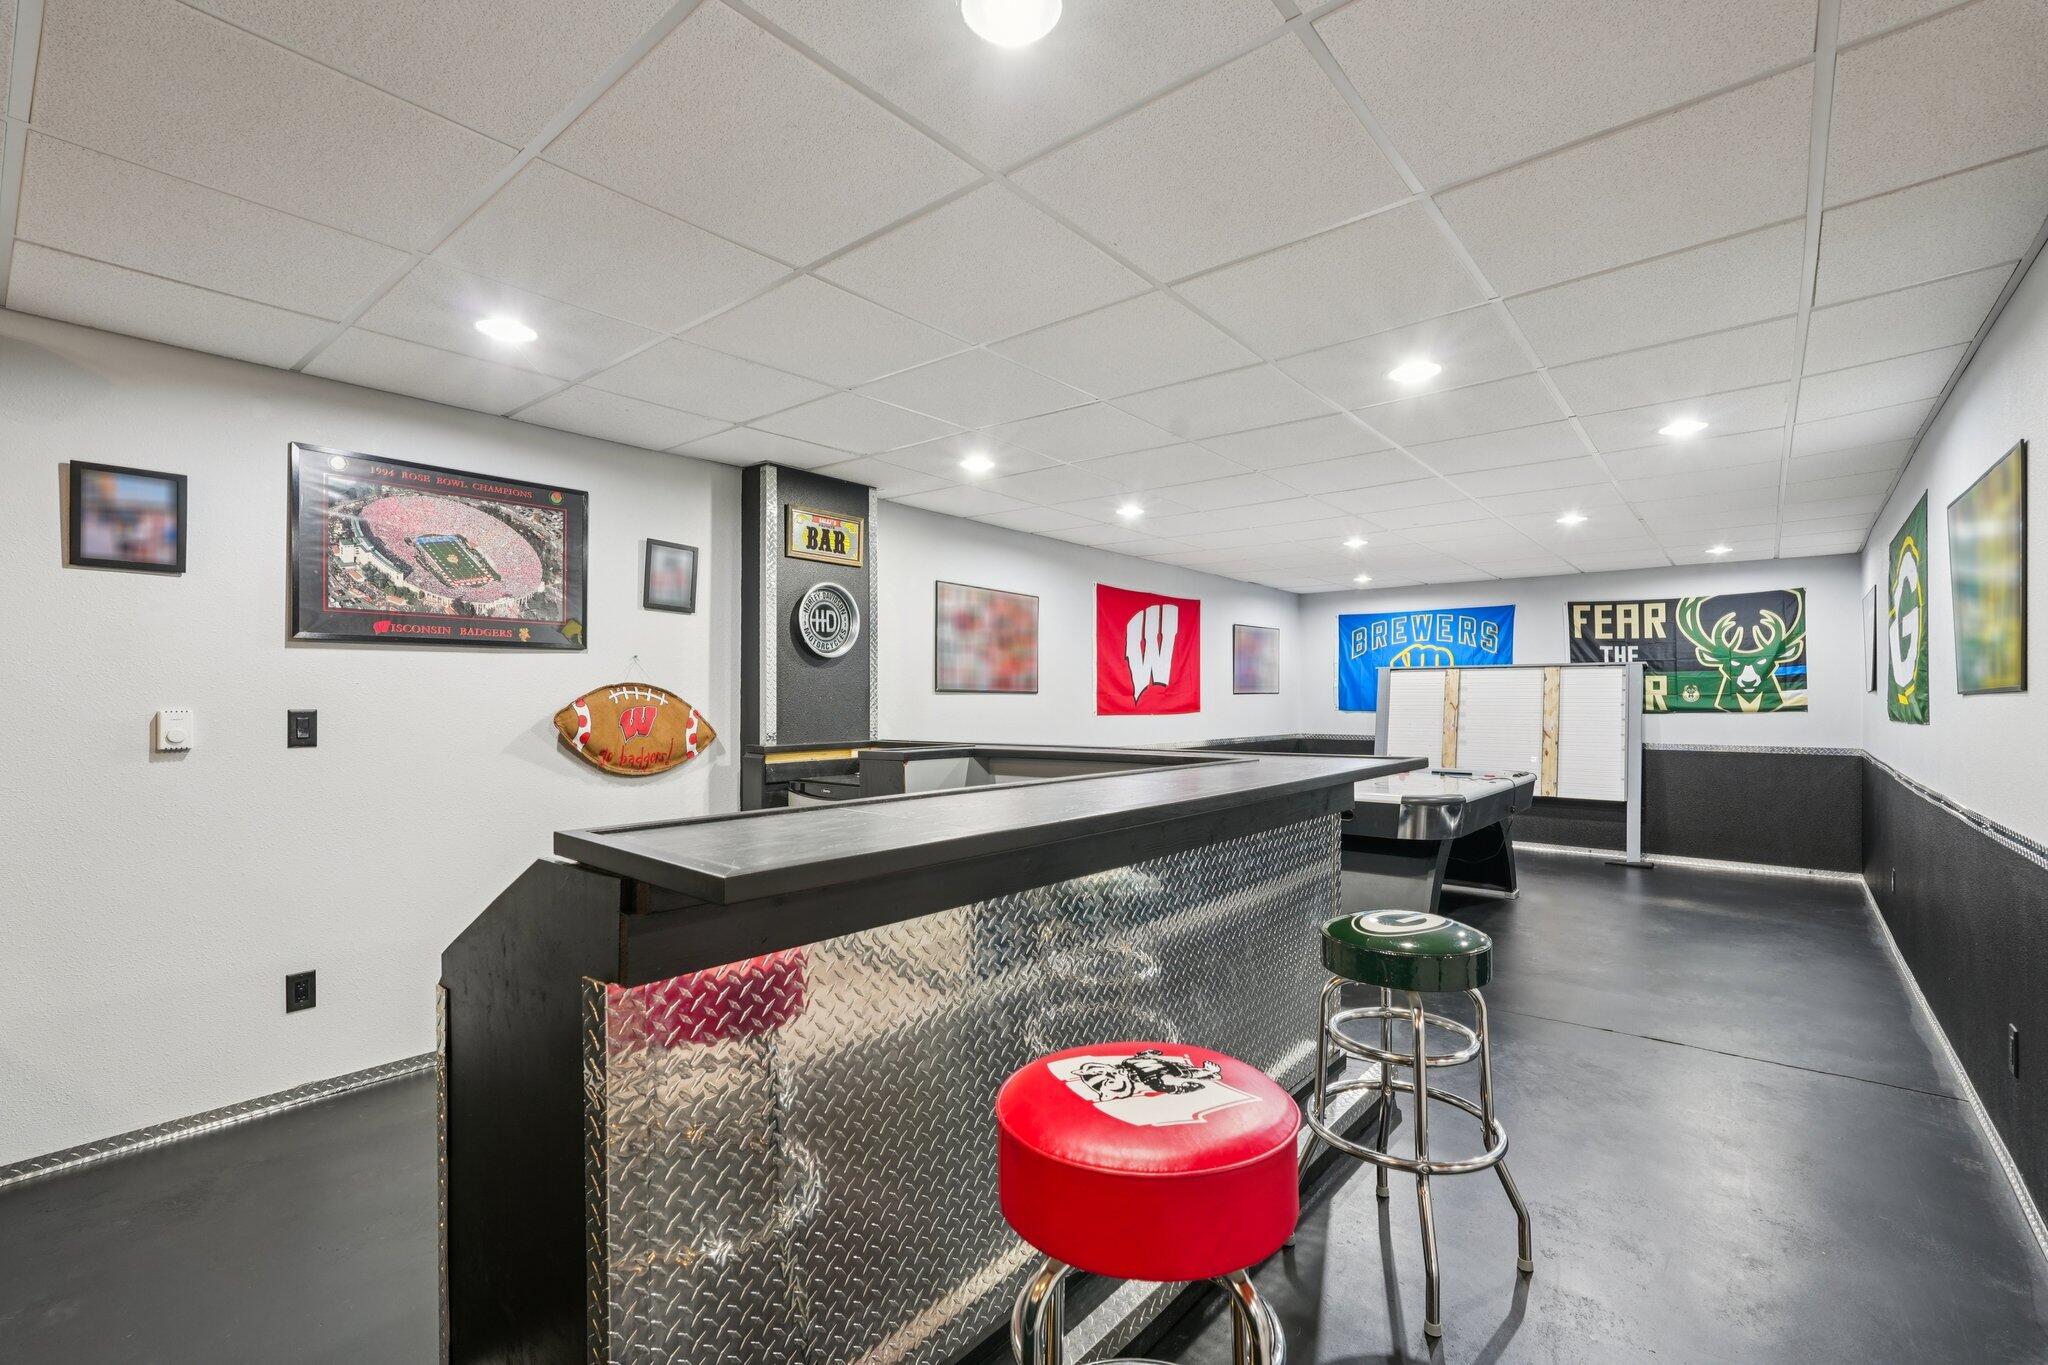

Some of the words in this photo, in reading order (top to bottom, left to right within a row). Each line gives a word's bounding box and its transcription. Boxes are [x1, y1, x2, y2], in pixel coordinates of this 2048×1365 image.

[369, 466, 395, 477] 1994
[401, 471, 431, 483] ROSE
[436, 476, 468, 488] BOWL
[472, 483, 533, 499] CHAMPIONS
[806, 526, 846, 555] BAR
[372, 619, 452, 635] WISCONSIN
[459, 627, 513, 638] BADGERS
[1351, 613, 1500, 660] BREWERS
[1572, 602, 1667, 639] FEAR
[803, 627, 847, 650] MOTORCYCLES
[1125, 603, 1179, 707] W
[1599, 645, 1639, 662] THE
[619, 705, 658, 744] W
